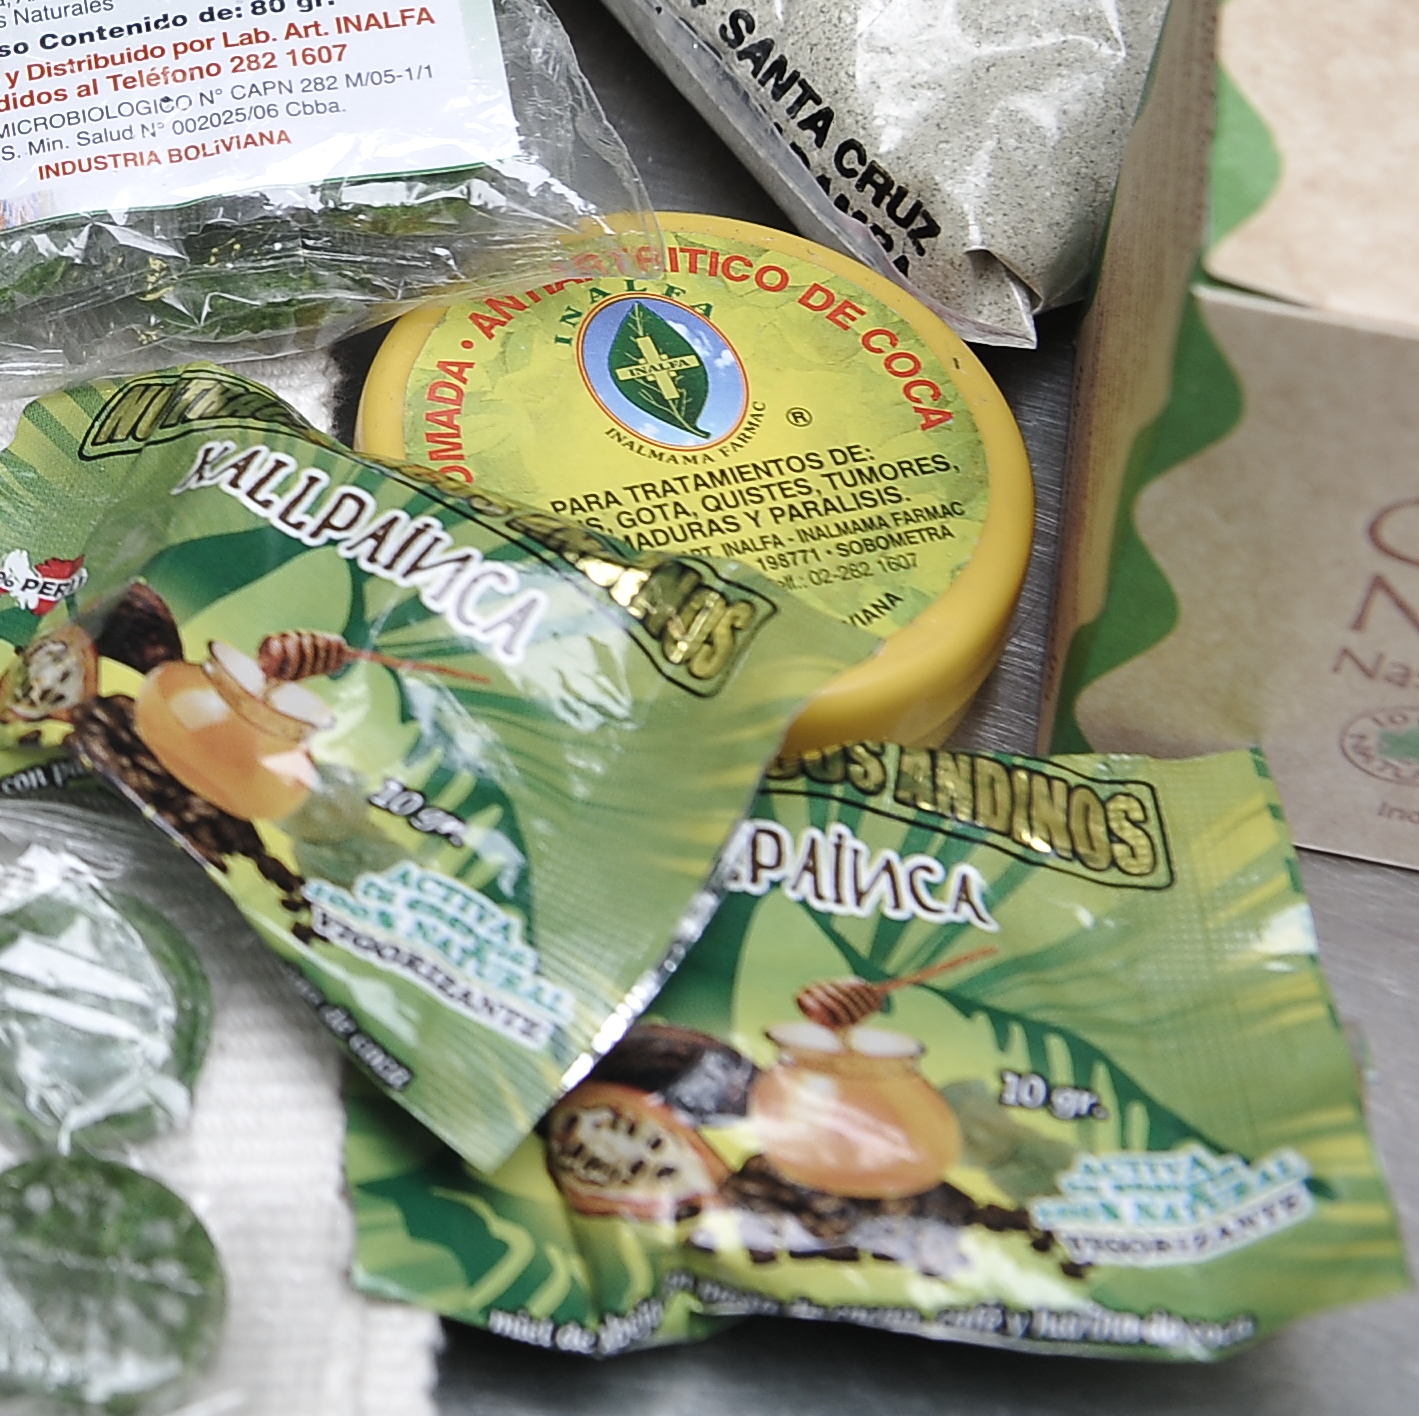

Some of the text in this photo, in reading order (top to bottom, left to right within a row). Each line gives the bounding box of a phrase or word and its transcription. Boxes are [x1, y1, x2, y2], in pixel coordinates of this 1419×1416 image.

[5, 69, 20, 90] y
[27, 43, 166, 82] Distribuido
[173, 36, 216, 61] por
[222, 28, 278, 48] Lab.
[284, 21, 330, 40] Art.
[335, 7, 436, 34] INALFA
[39, 13, 188, 50] Contenido
[198, 6, 243, 24] de:
[77, 78, 99, 97] al
[107, 62, 222, 93] Teléfono
[230, 51, 278, 74] 282
[286, 44, 348, 67] 1607
[230, 79, 294, 101] CAPN
[300, 75, 339, 93] 282
[345, 64, 433, 89] M/05-1/1
[28, 138, 69, 157] Min.
[76, 124, 133, 147] Salud
[172, 103, 279, 136] 002025/06
[285, 99, 346, 118] Cbba.
[719, 8, 835, 150] SANTA
[833, 138, 942, 257] CRUZ
[38, 150, 162, 181] INDUSTRIA
[554, 279, 714, 346] INALFA
[425, 360, 476, 484] OMADA
[797, 282, 867, 332] DE
[861, 327, 954, 432] COCA
[627, 358, 692, 378] INALFA
[605, 400, 767, 466] INALMAMA FARMAC
[550, 444, 876, 517] PARA TRATAMIENTOS DE:
[616, 500, 698, 531] GOTA,
[700, 479, 823, 514] QUISTES,
[825, 453, 961, 489] TUMORES,
[745, 486, 912, 528] Y PARALISIS.
[722, 500, 966, 558] INALFA INALMAMA FARMAC
[757, 524, 956, 572] 198771 SOBOMETRA
[810, 561, 873, 588] 02-282
[877, 554, 919, 576] 1607
[367, 778, 425, 816] 10
[894, 744, 1157, 876] ANDINOS
[1000, 1069, 1049, 1110] 10
